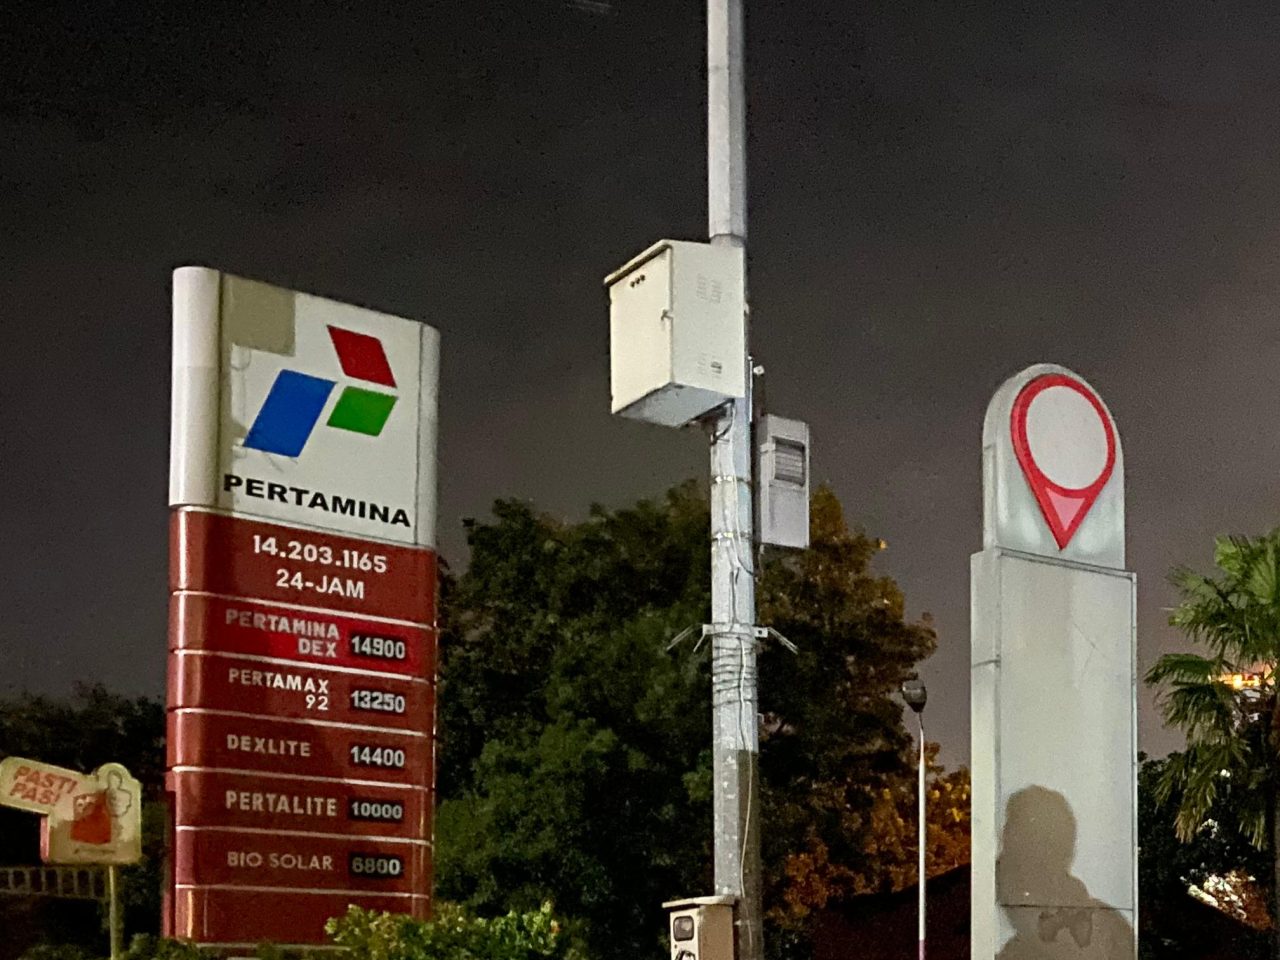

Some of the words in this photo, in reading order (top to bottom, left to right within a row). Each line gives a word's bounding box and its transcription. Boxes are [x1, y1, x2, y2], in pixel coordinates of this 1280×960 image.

[223, 473, 412, 528] PERTAMINA
[253, 535, 388, 574] 14.203.1165
[276, 569, 366, 600] 24-JAM
[225, 609, 340, 640] PERTAMINA
[298, 638, 337, 658] DEX
[351, 636, 406, 660] 14900
[228, 668, 329, 694] PERTAMAX
[305, 694, 329, 710] 92
[350, 690, 406, 713] 13250
[227, 734, 312, 757] DEXLITE
[350, 746, 406, 767] 14400
[13, 765, 78, 795] PASTI
[225, 790, 338, 817] PERTALITE
[351, 801, 404, 819] 10000
[227, 851, 262, 868] BIO
[269, 852, 334, 871] SOLAR
